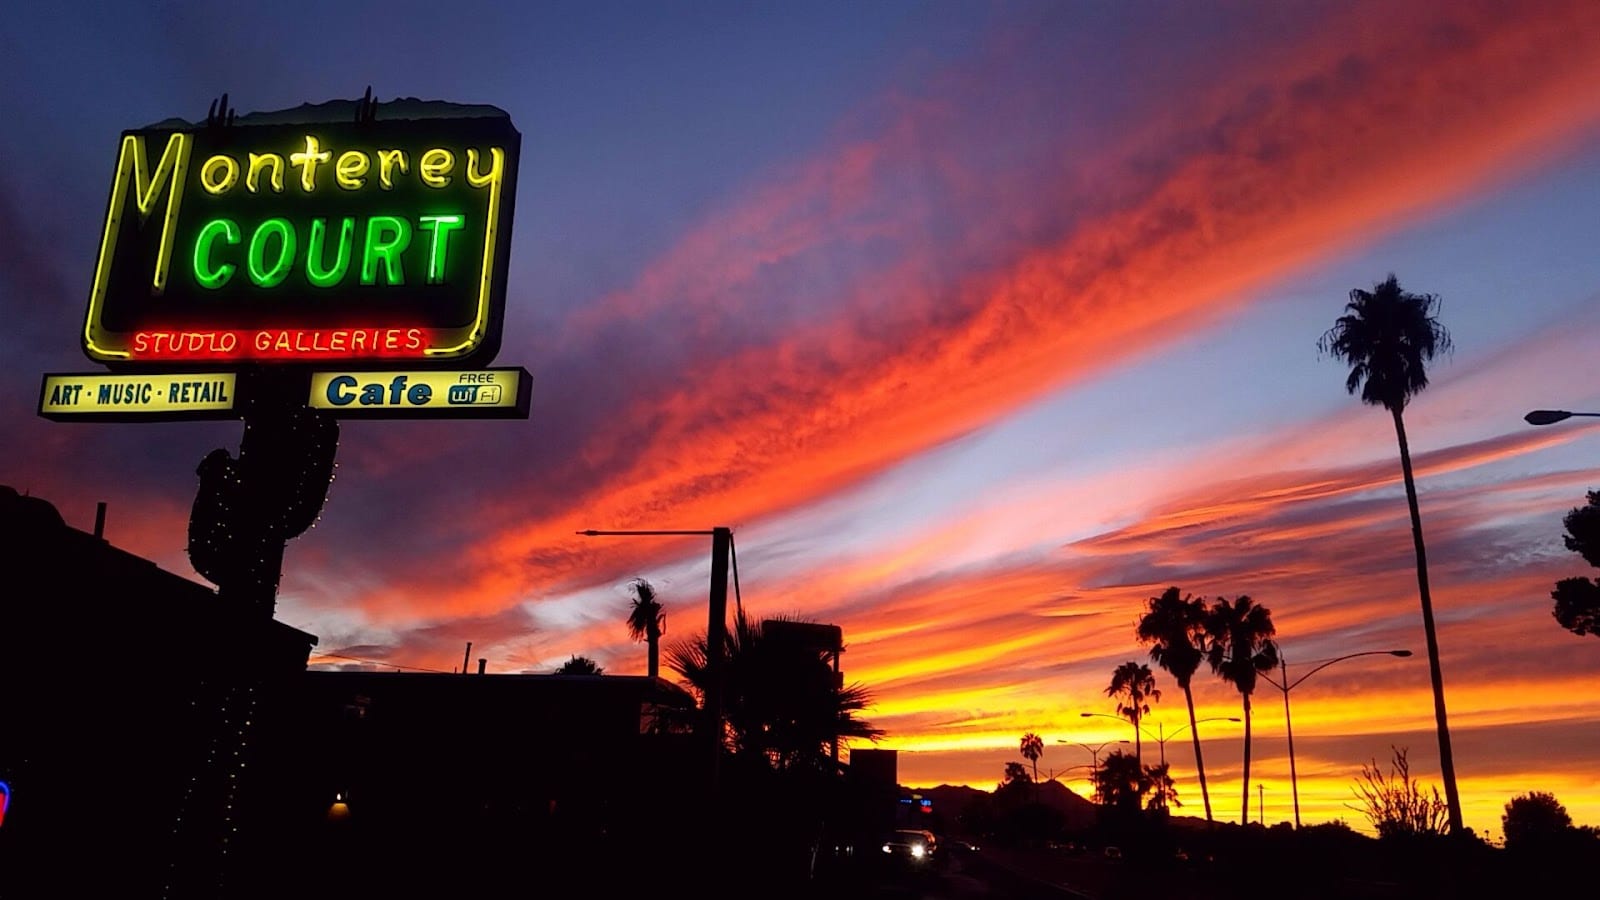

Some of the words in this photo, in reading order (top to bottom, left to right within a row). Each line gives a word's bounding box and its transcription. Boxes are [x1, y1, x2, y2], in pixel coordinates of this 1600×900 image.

[98, 132, 506, 292] Monterey
[193, 213, 466, 289] COURT
[134, 332, 237, 353] STUDIO
[255, 329, 421, 351] GALLERIES
[326, 375, 432, 406] Cafe
[459, 373, 495, 384] FREE
[50, 384, 83, 406] ART
[97, 383, 152, 405] MUSIC
[168, 381, 228, 404] RETAIL
